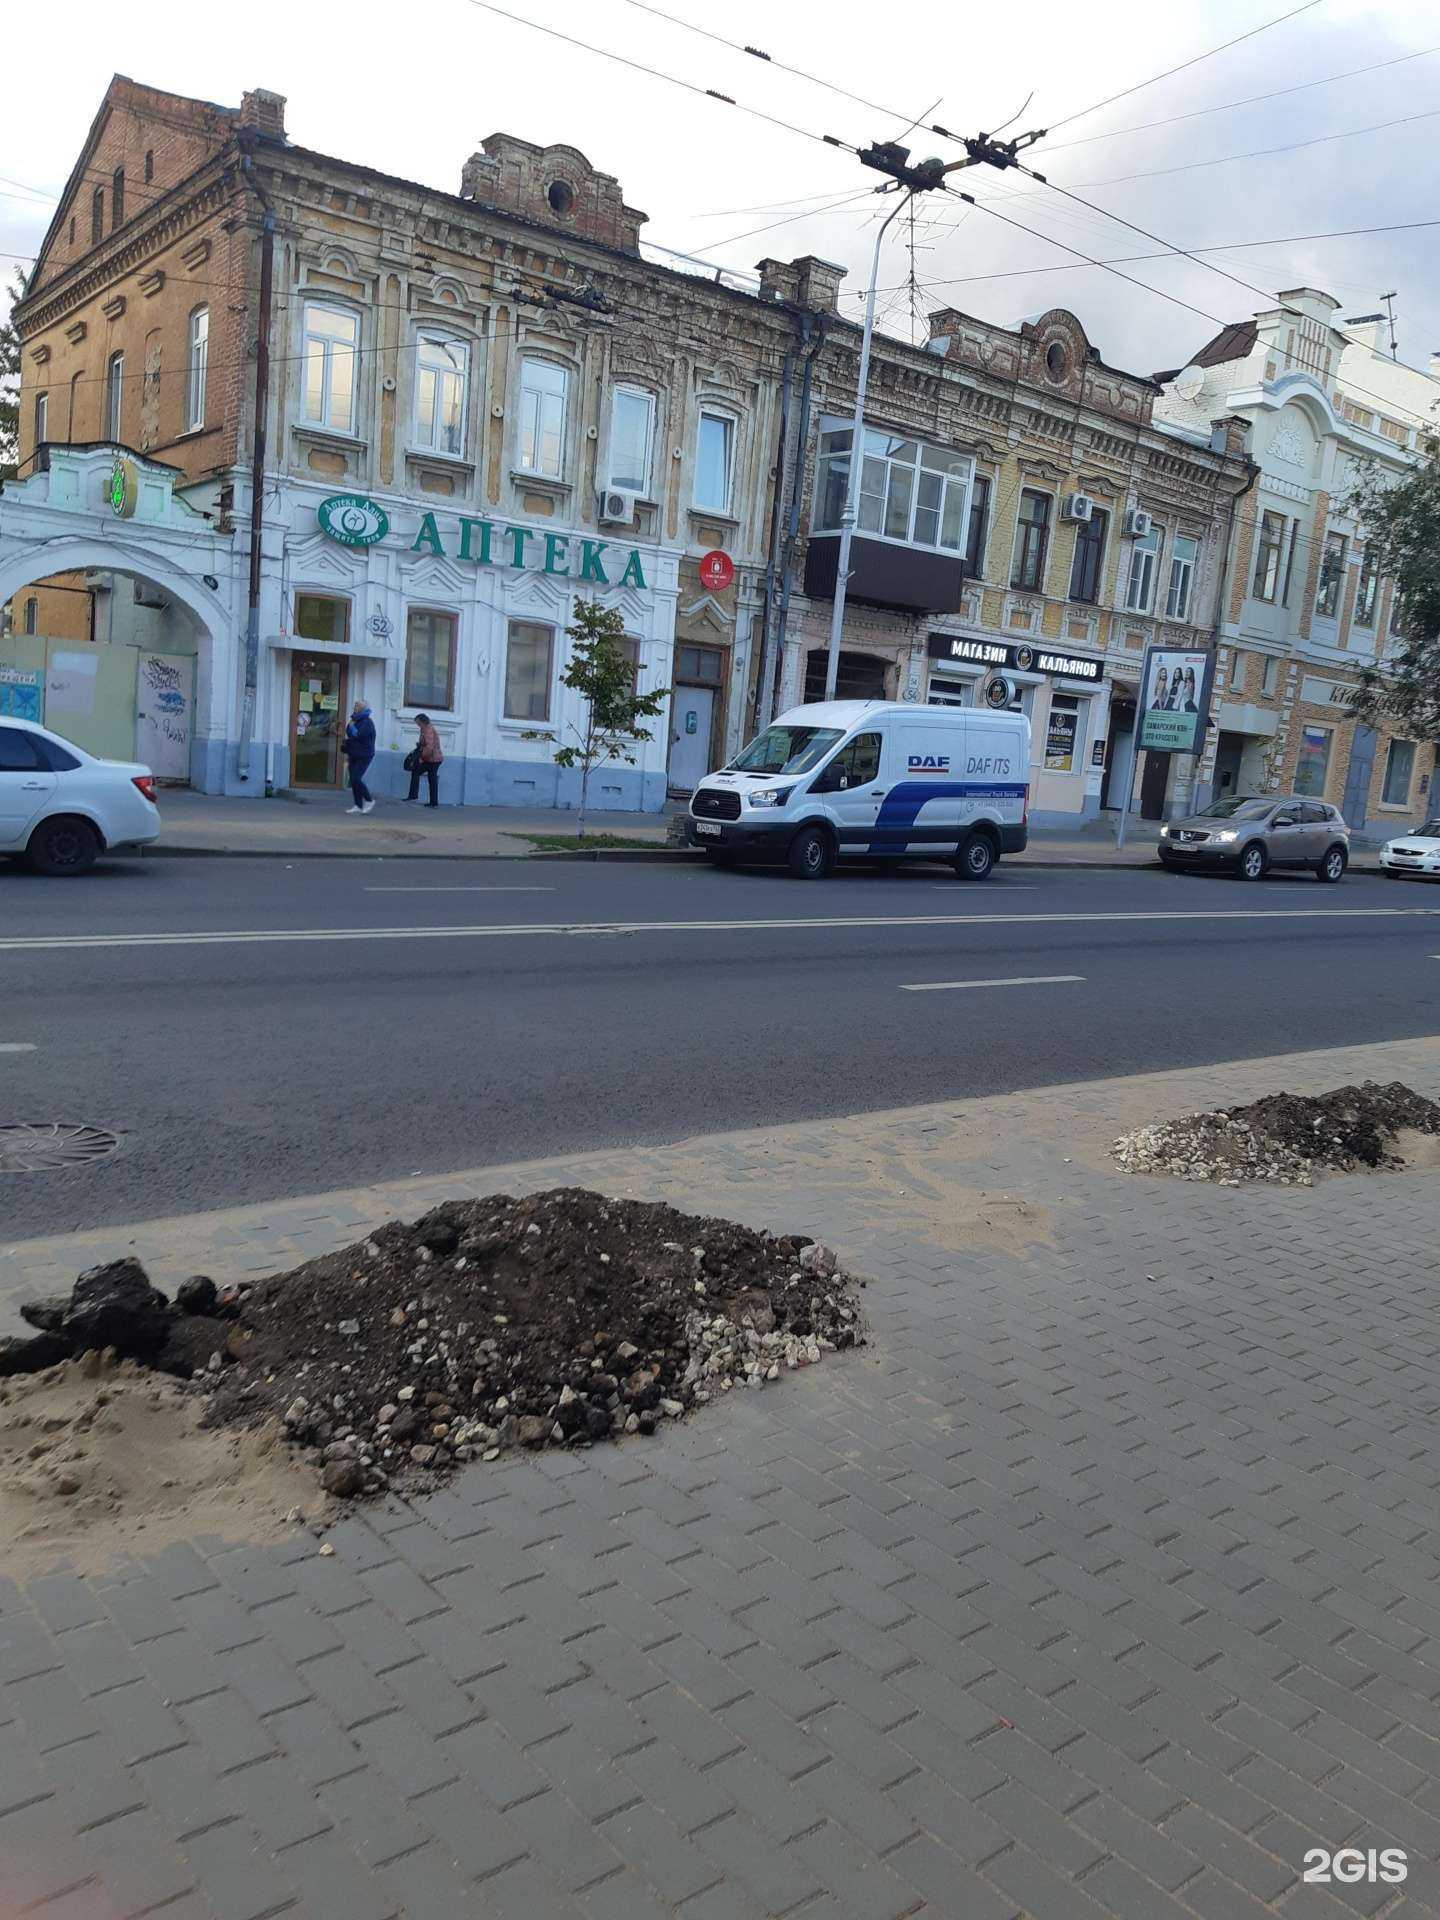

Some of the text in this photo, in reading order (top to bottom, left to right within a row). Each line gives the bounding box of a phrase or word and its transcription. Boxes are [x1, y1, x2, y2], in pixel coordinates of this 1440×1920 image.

[325, 499, 357, 514] Аптека
[410, 511, 648, 589] АПТЕКА
[373, 618, 387, 633] 52
[952, 640, 1098, 678] МАГАЗИН КАЛЬЯНОВ
[908, 756, 950, 767] DAF
[966, 757, 1010, 775] DAF ITS
